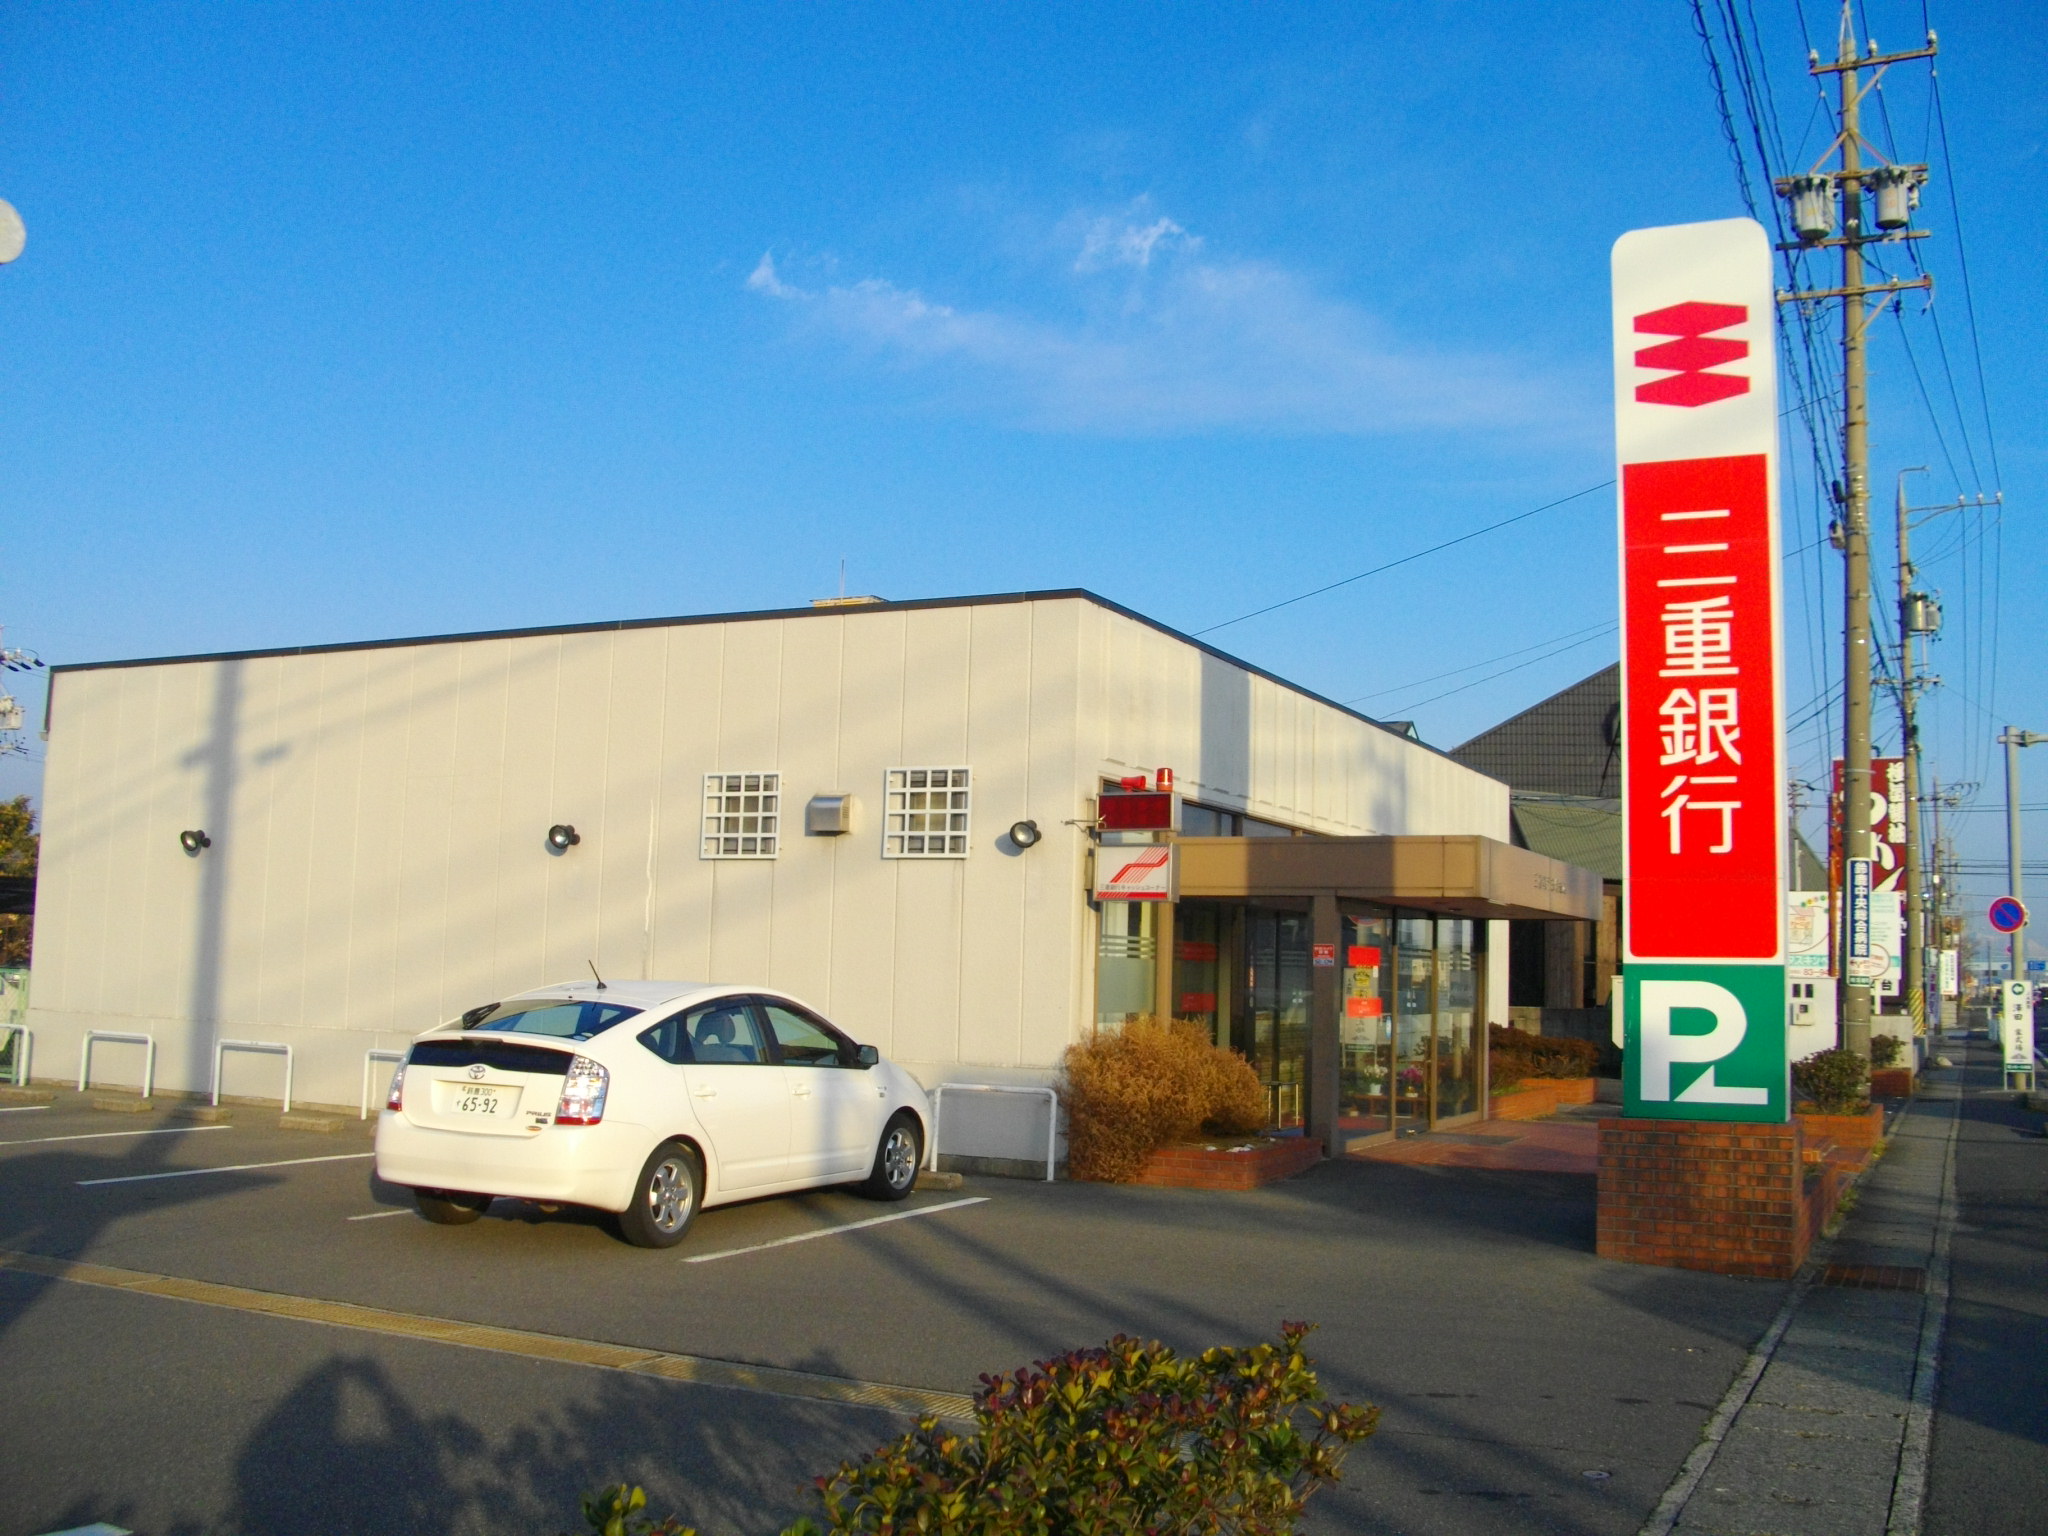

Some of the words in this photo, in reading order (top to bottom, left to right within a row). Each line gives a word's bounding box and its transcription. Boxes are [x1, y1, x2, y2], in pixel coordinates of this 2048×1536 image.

[1656, 508, 1742, 855] 三重銀行
[1639, 979, 1748, 1102] P
[462, 1097, 498, 1113] 65-92
